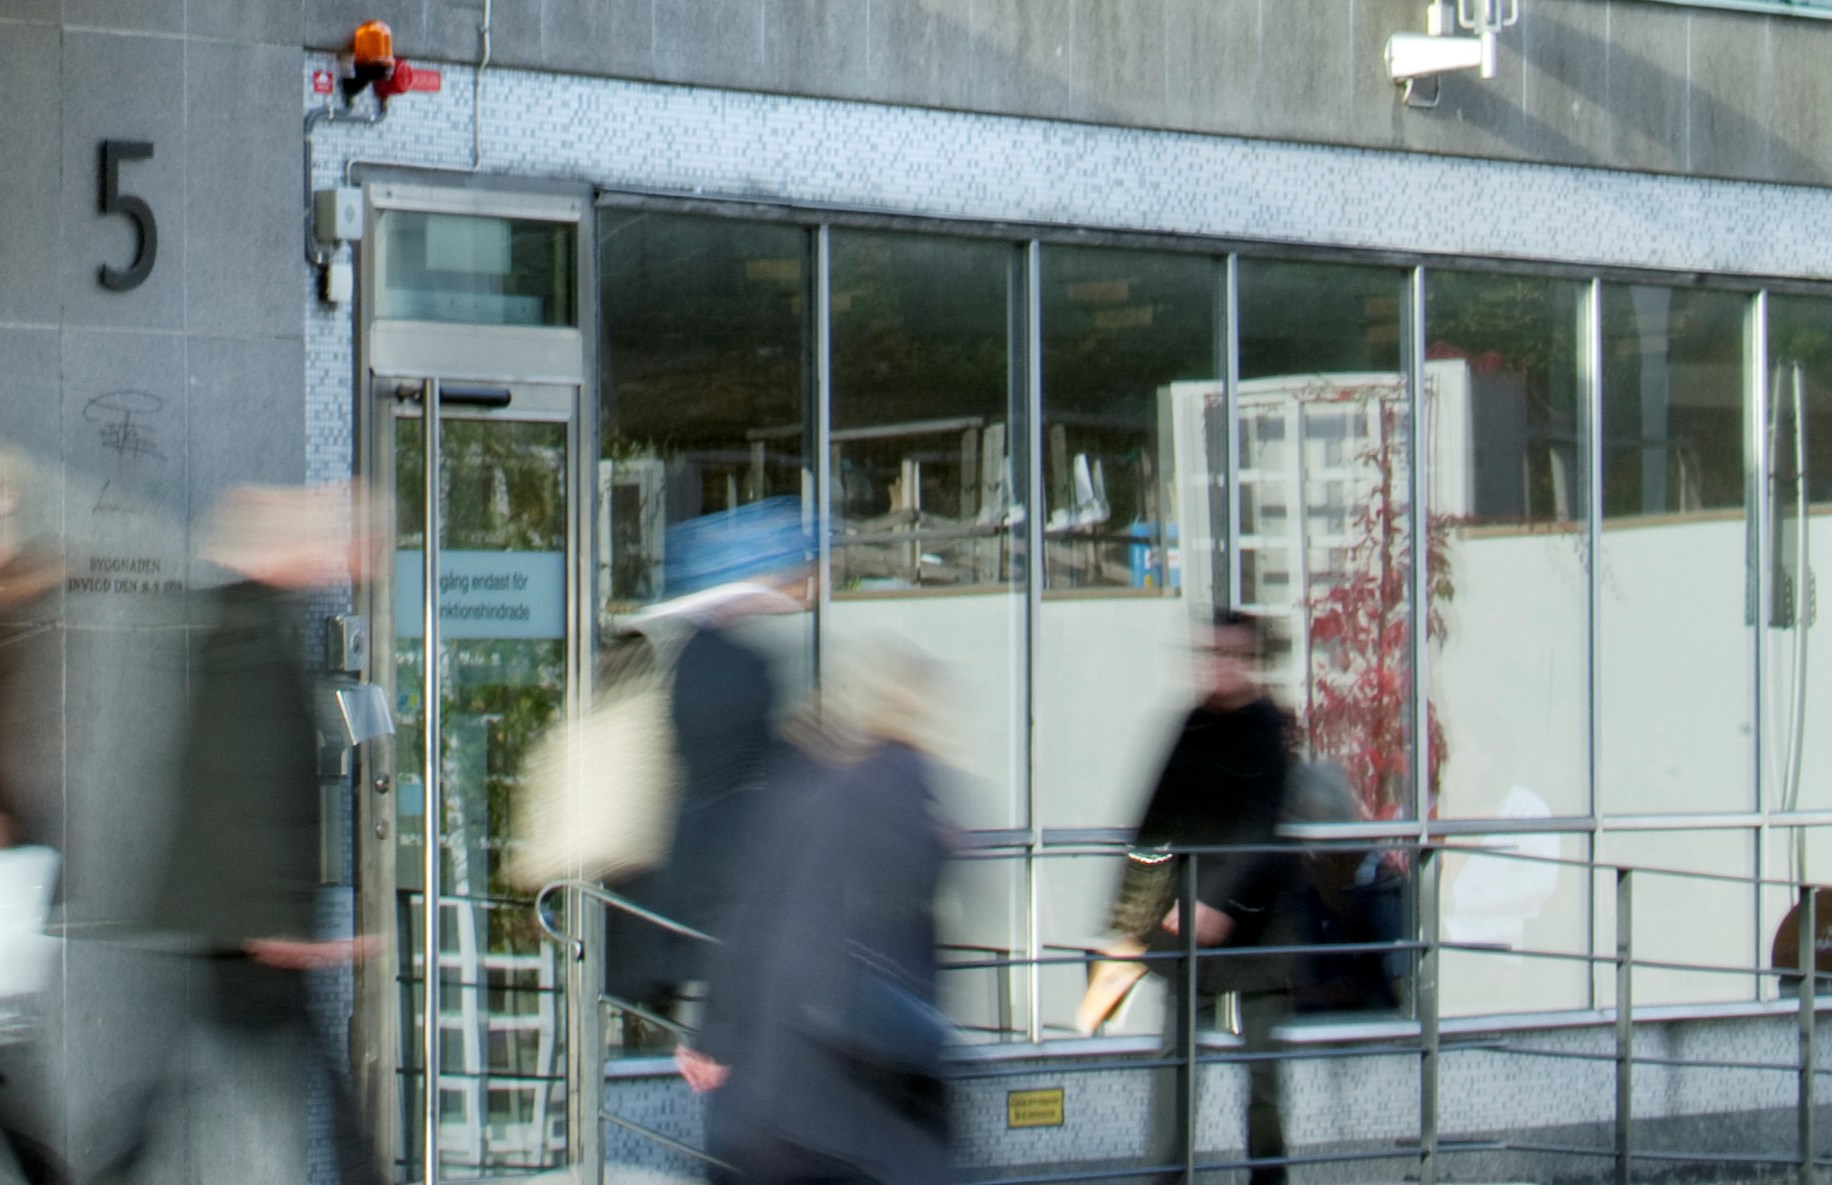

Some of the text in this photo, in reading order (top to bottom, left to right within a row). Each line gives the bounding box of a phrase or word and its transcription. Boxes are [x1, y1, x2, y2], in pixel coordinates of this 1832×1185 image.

[97, 138, 159, 292] 5
[472, 572, 510, 591] endast
[512, 571, 529, 591] för
